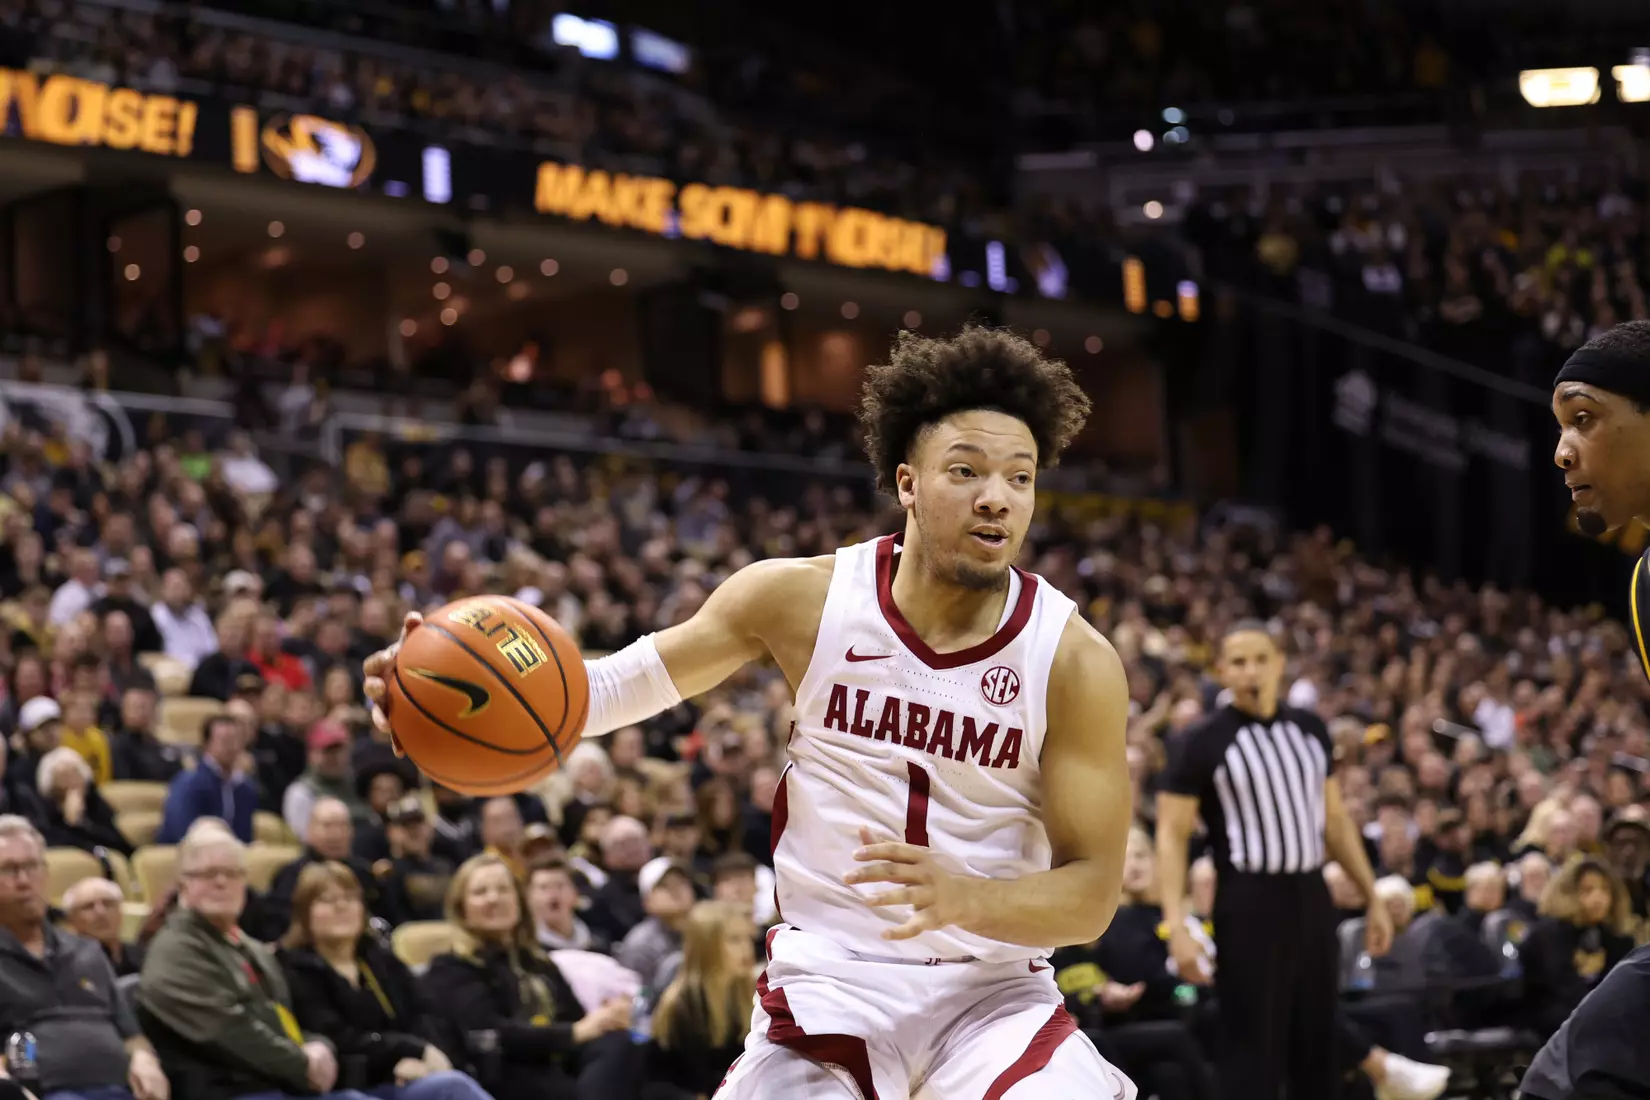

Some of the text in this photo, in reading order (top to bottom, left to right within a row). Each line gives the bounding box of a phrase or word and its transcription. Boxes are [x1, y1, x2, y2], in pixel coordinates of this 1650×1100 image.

[535, 161, 675, 233] MAKE
[679, 182, 794, 256] SOM
[824, 684, 1022, 768] ALABAMA
[982, 667, 1019, 704] SEC
[905, 761, 930, 847] 1
